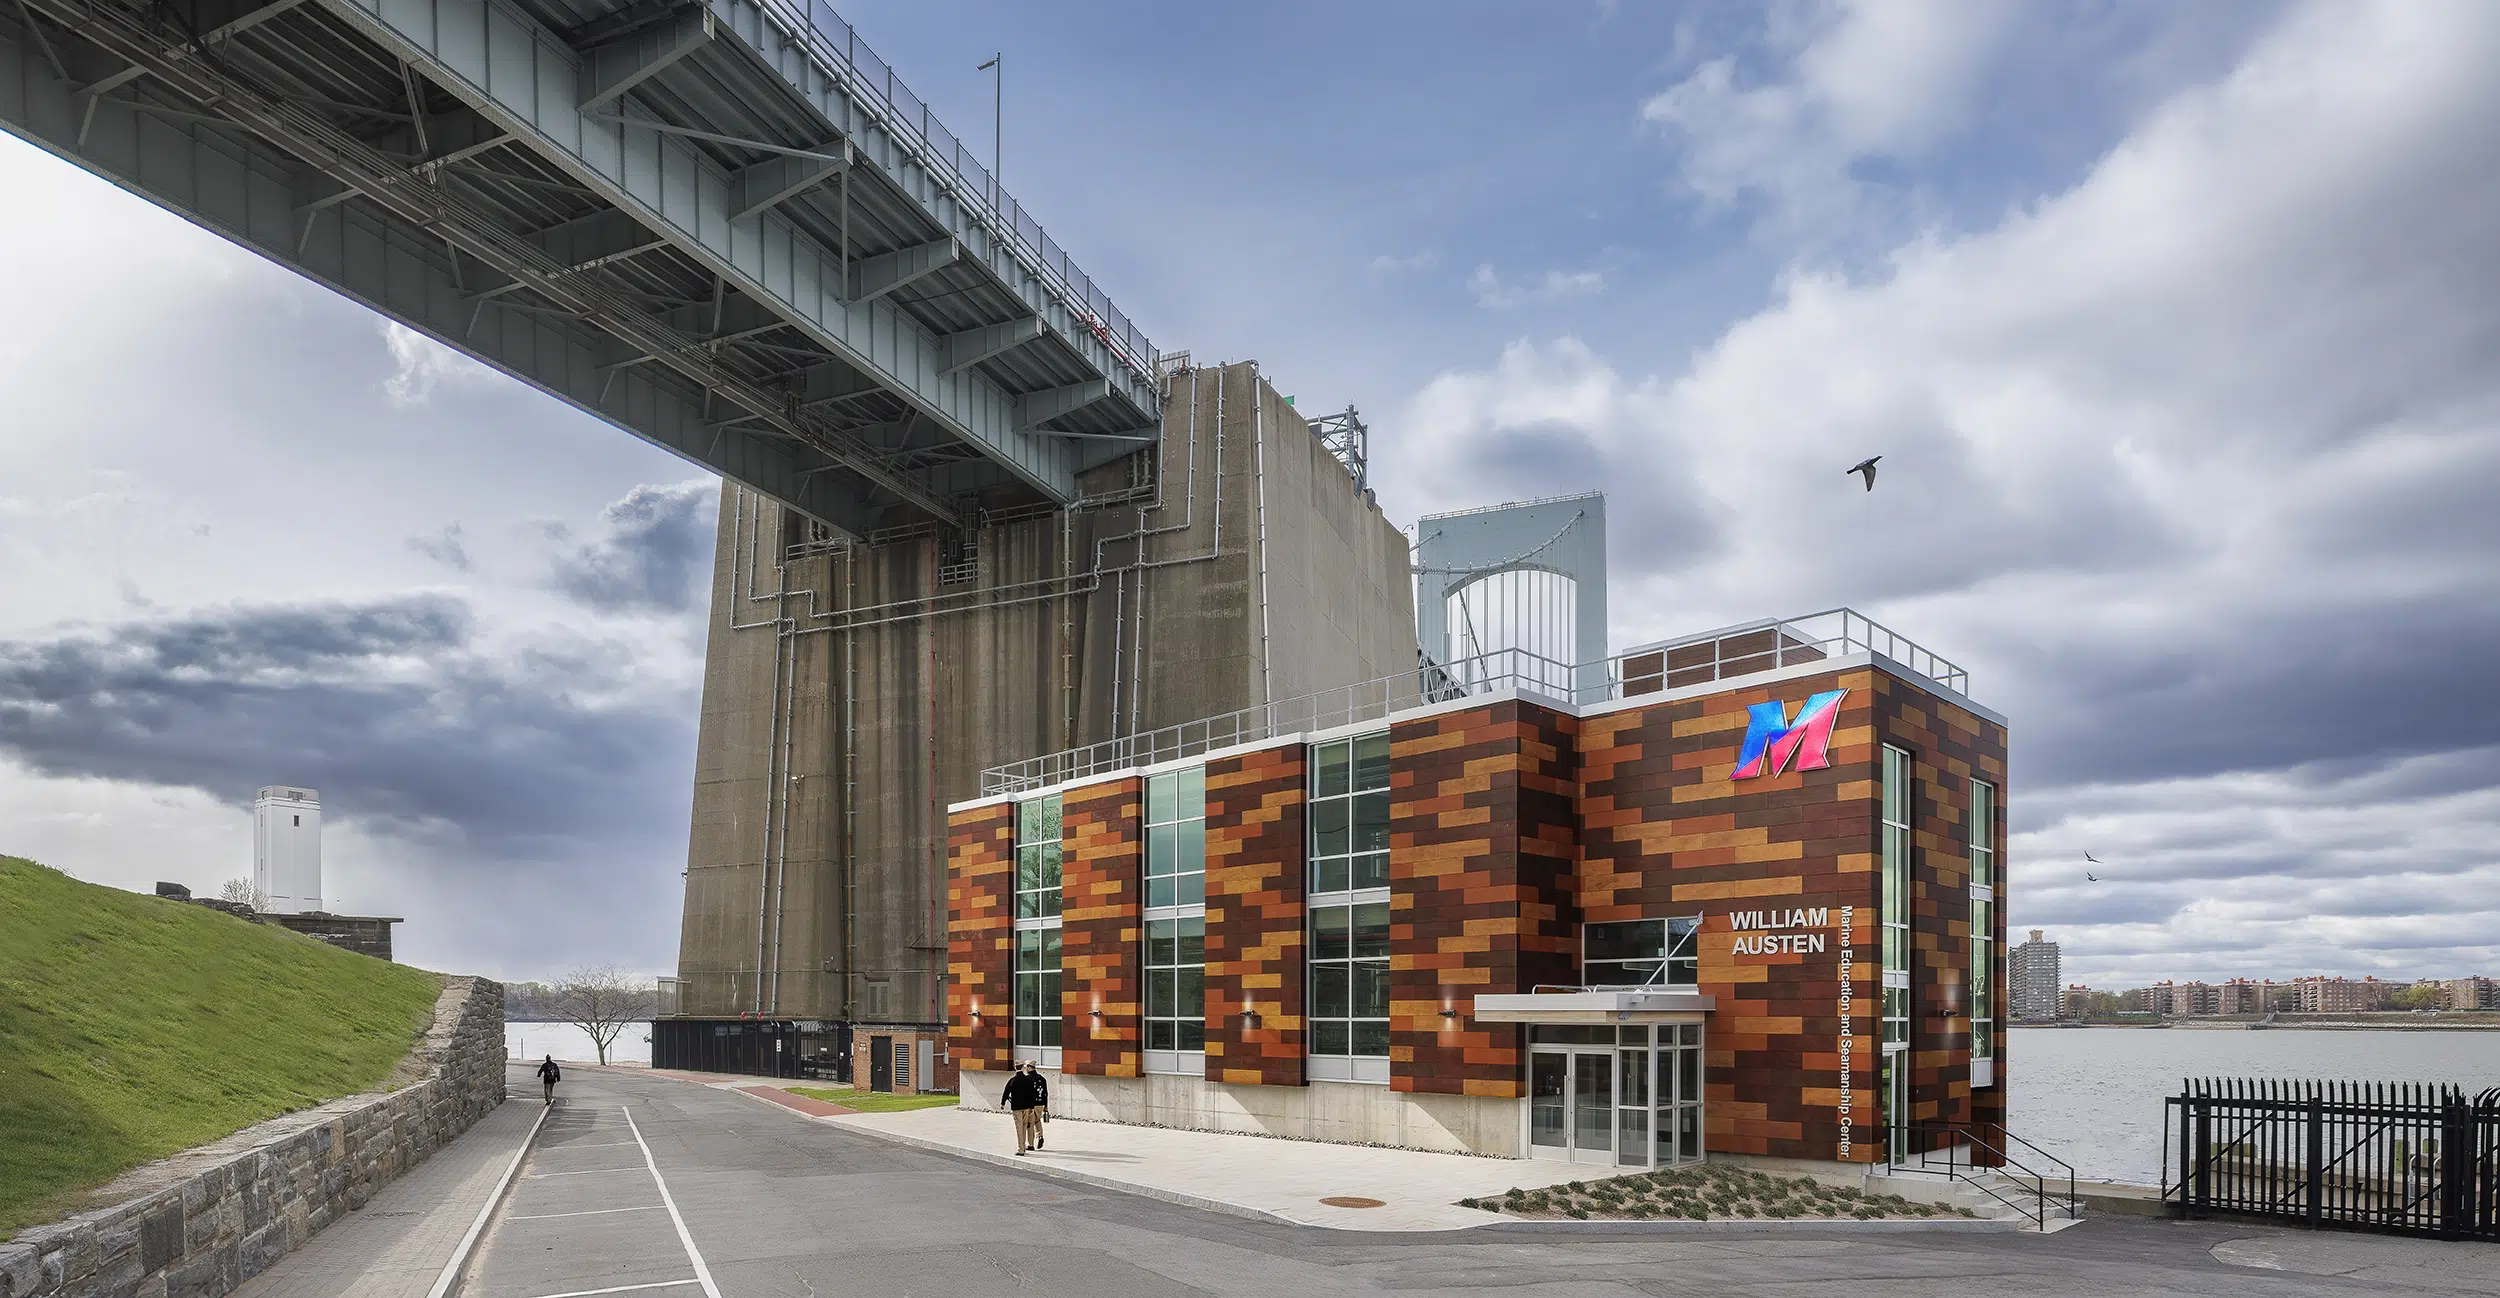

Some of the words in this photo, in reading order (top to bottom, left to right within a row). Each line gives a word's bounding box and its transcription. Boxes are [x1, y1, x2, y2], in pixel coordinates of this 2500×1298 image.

[1728, 688, 1850, 781] M
[1729, 907, 1828, 930] WILLIAM
[1841, 905, 1853, 947] Marine
[1732, 934, 1825, 955] AUSTEN
[1841, 950, 1853, 1011] Education
[1841, 1013, 1853, 1037] and
[1838, 1039, 1853, 1115] Seamanship
[1841, 1116, 1853, 1158] Center
